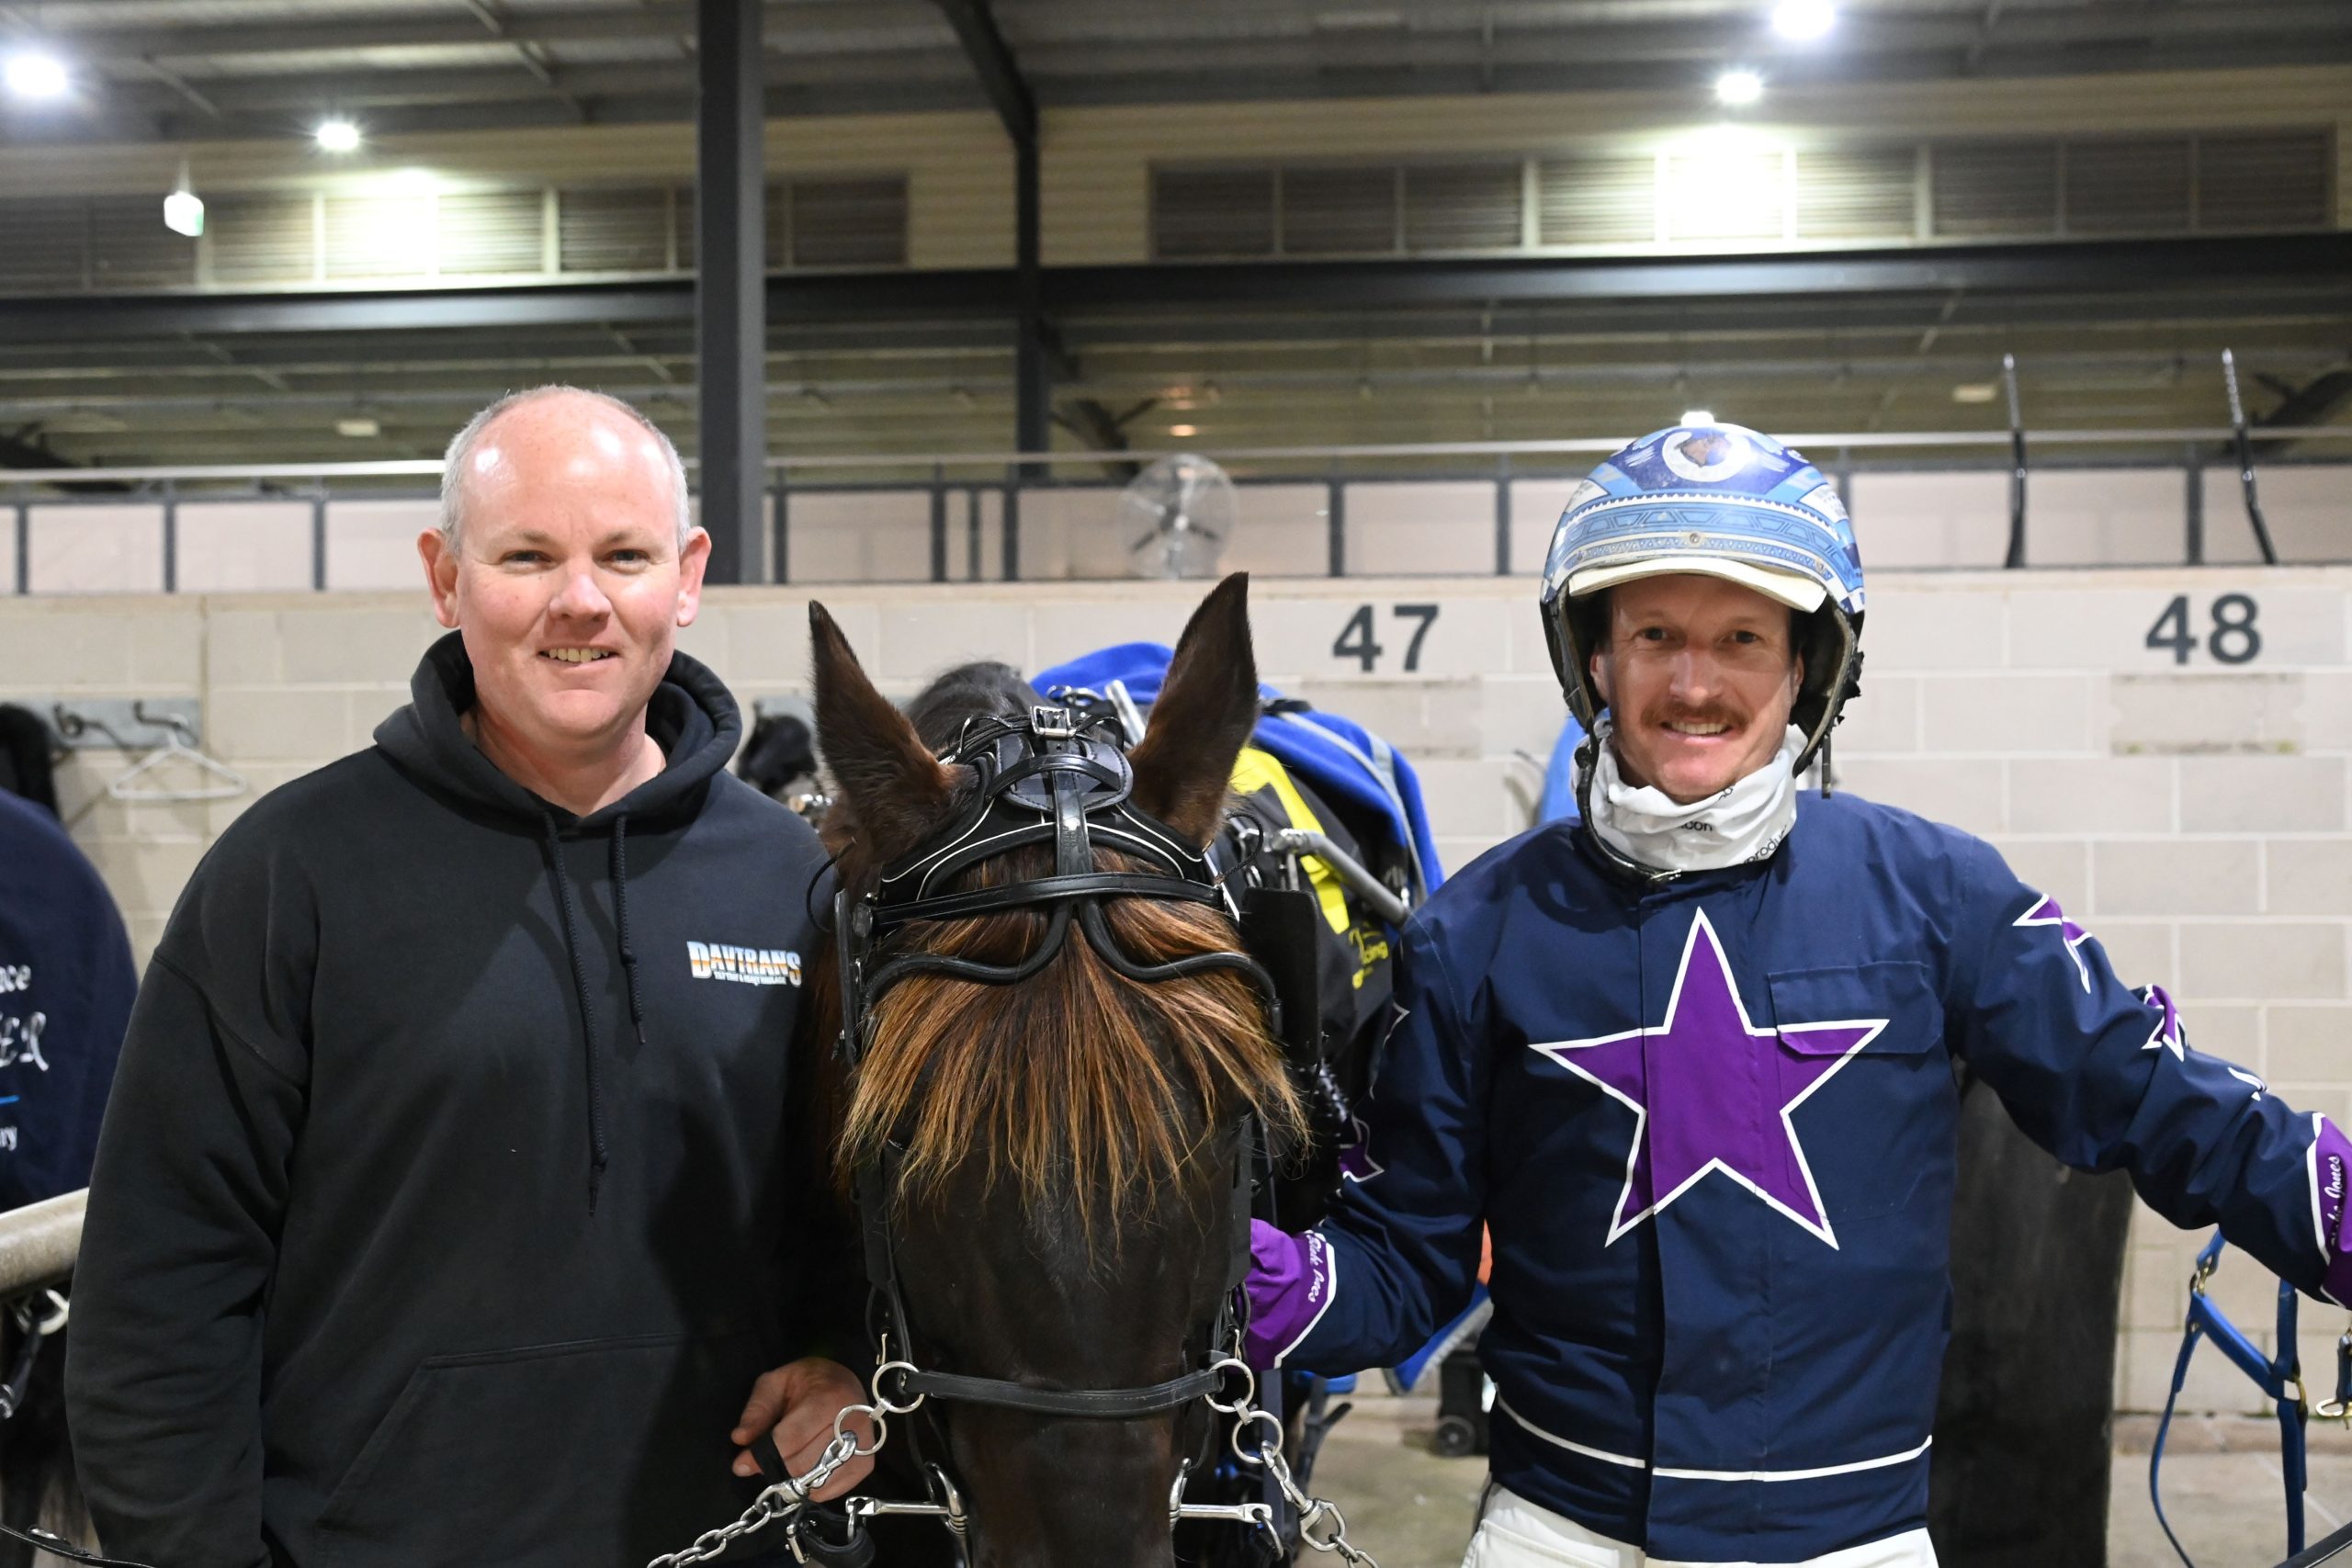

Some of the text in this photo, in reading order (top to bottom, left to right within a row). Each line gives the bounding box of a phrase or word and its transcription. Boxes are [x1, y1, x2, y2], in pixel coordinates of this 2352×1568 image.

[1332, 604, 1440, 672] 47
[2145, 593, 2262, 665] 48
[686, 941, 802, 987] DAVTRANS
[2324, 1156, 2343, 1199] Jones
